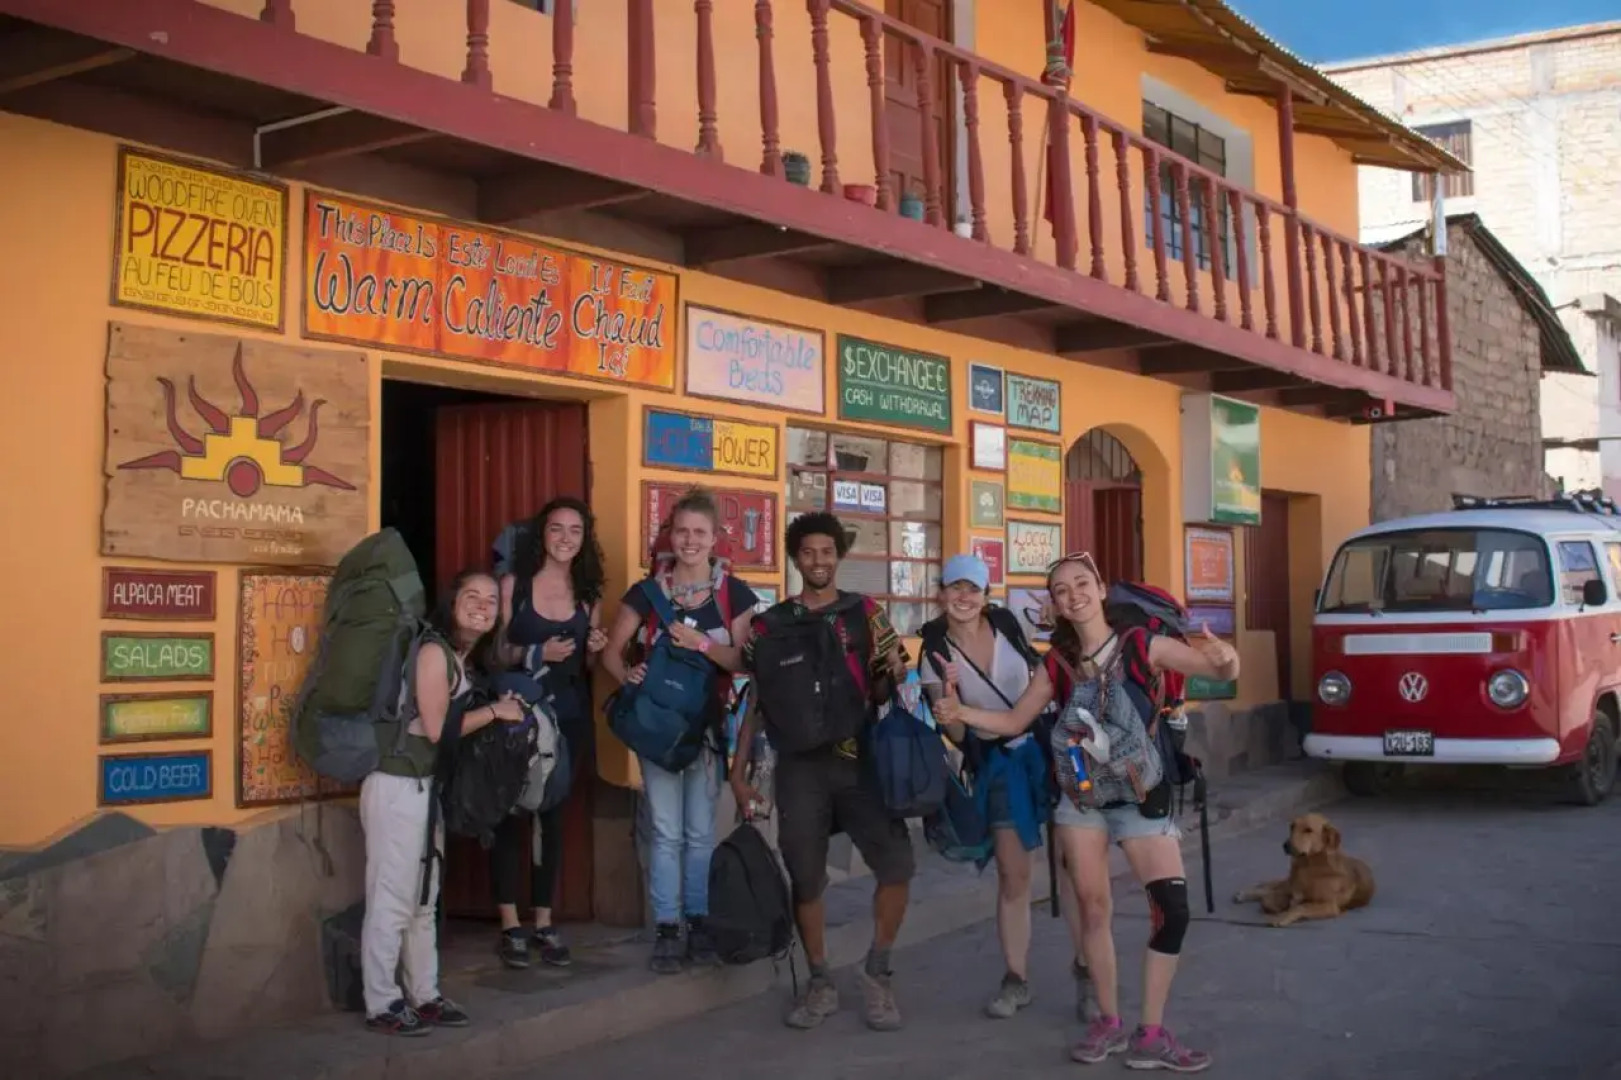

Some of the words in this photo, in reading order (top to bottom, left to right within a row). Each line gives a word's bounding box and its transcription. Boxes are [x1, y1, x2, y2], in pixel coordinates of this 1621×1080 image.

[127, 174, 228, 218] WOODFIRE
[233, 192, 278, 229] OVEN
[127, 202, 274, 280] PIZZERIA
[317, 203, 366, 247] This
[368, 213, 413, 253] Place
[417, 225, 437, 259] Is
[448, 234, 490, 268] Este
[124, 256, 153, 287] AU
[156, 262, 191, 293] FEU
[200, 270, 223, 298] DE
[230, 276, 274, 309] BOIS
[313, 251, 434, 324] Warm
[444, 274, 562, 349] Caliente
[572, 292, 663, 349] Chaud
[696, 321, 817, 371] Comfortable
[728, 358, 785, 396] Beds
[845, 387, 874, 407] CASH
[879, 394, 947, 421] WITHDRAWAL
[1017, 403, 1053, 425] MAP
[836, 485, 858, 500] VISA
[863, 488, 884, 503] VISA
[182, 498, 305, 524] PACHAMAMA
[113, 582, 163, 607] ALPACA
[166, 583, 205, 607] MEAT
[113, 644, 204, 670] SALADS
[108, 766, 158, 793] COLD
[160, 763, 202, 791] BEER
